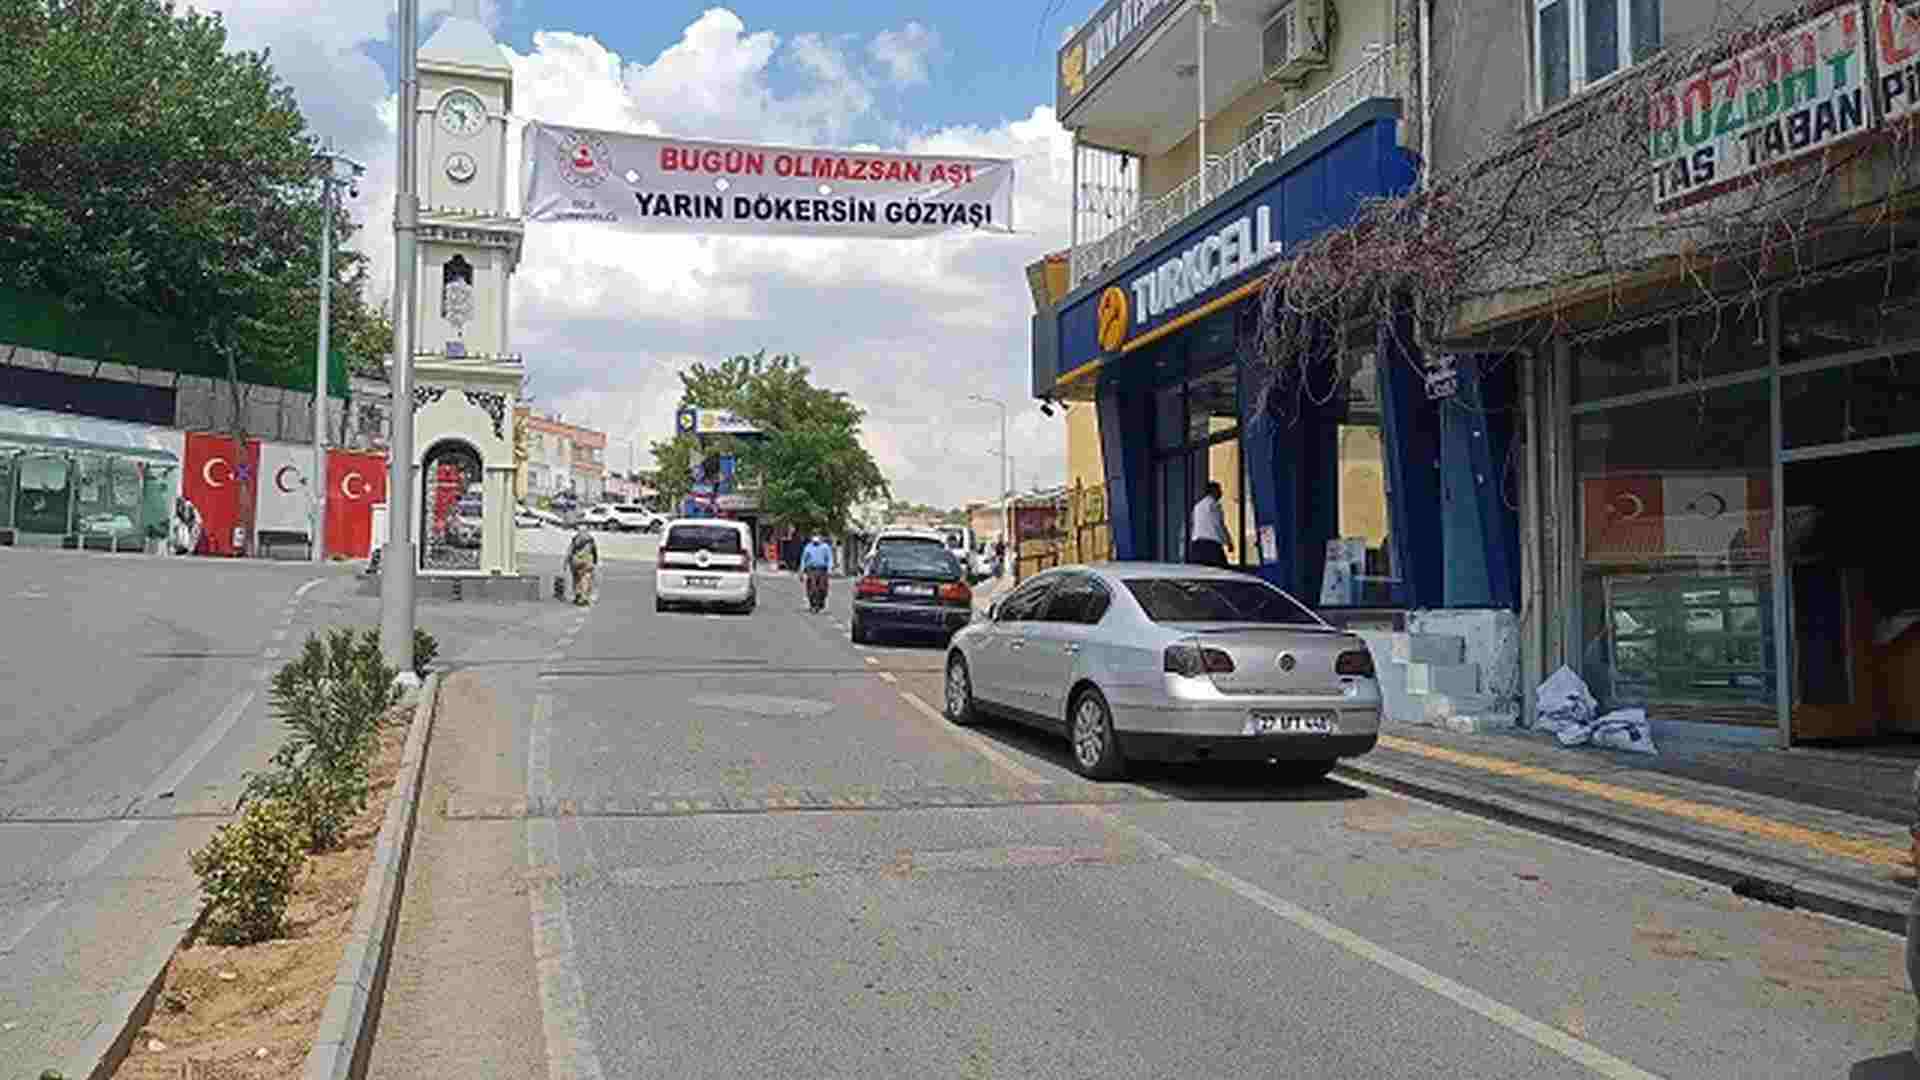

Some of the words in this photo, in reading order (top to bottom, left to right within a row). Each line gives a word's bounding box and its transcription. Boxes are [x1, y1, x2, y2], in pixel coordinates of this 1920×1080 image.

[1739, 87, 1862, 166] TABAN
[660, 146, 764, 176] BUGÜN
[774, 153, 923, 183] OLMAZSAN
[929, 161, 973, 190] AŞI
[634, 191, 723, 219] YARIN
[733, 192, 876, 223] DÖKERSİN
[884, 197, 992, 228] GÖZYAŞI
[1131, 205, 1282, 324] TURKCELL
